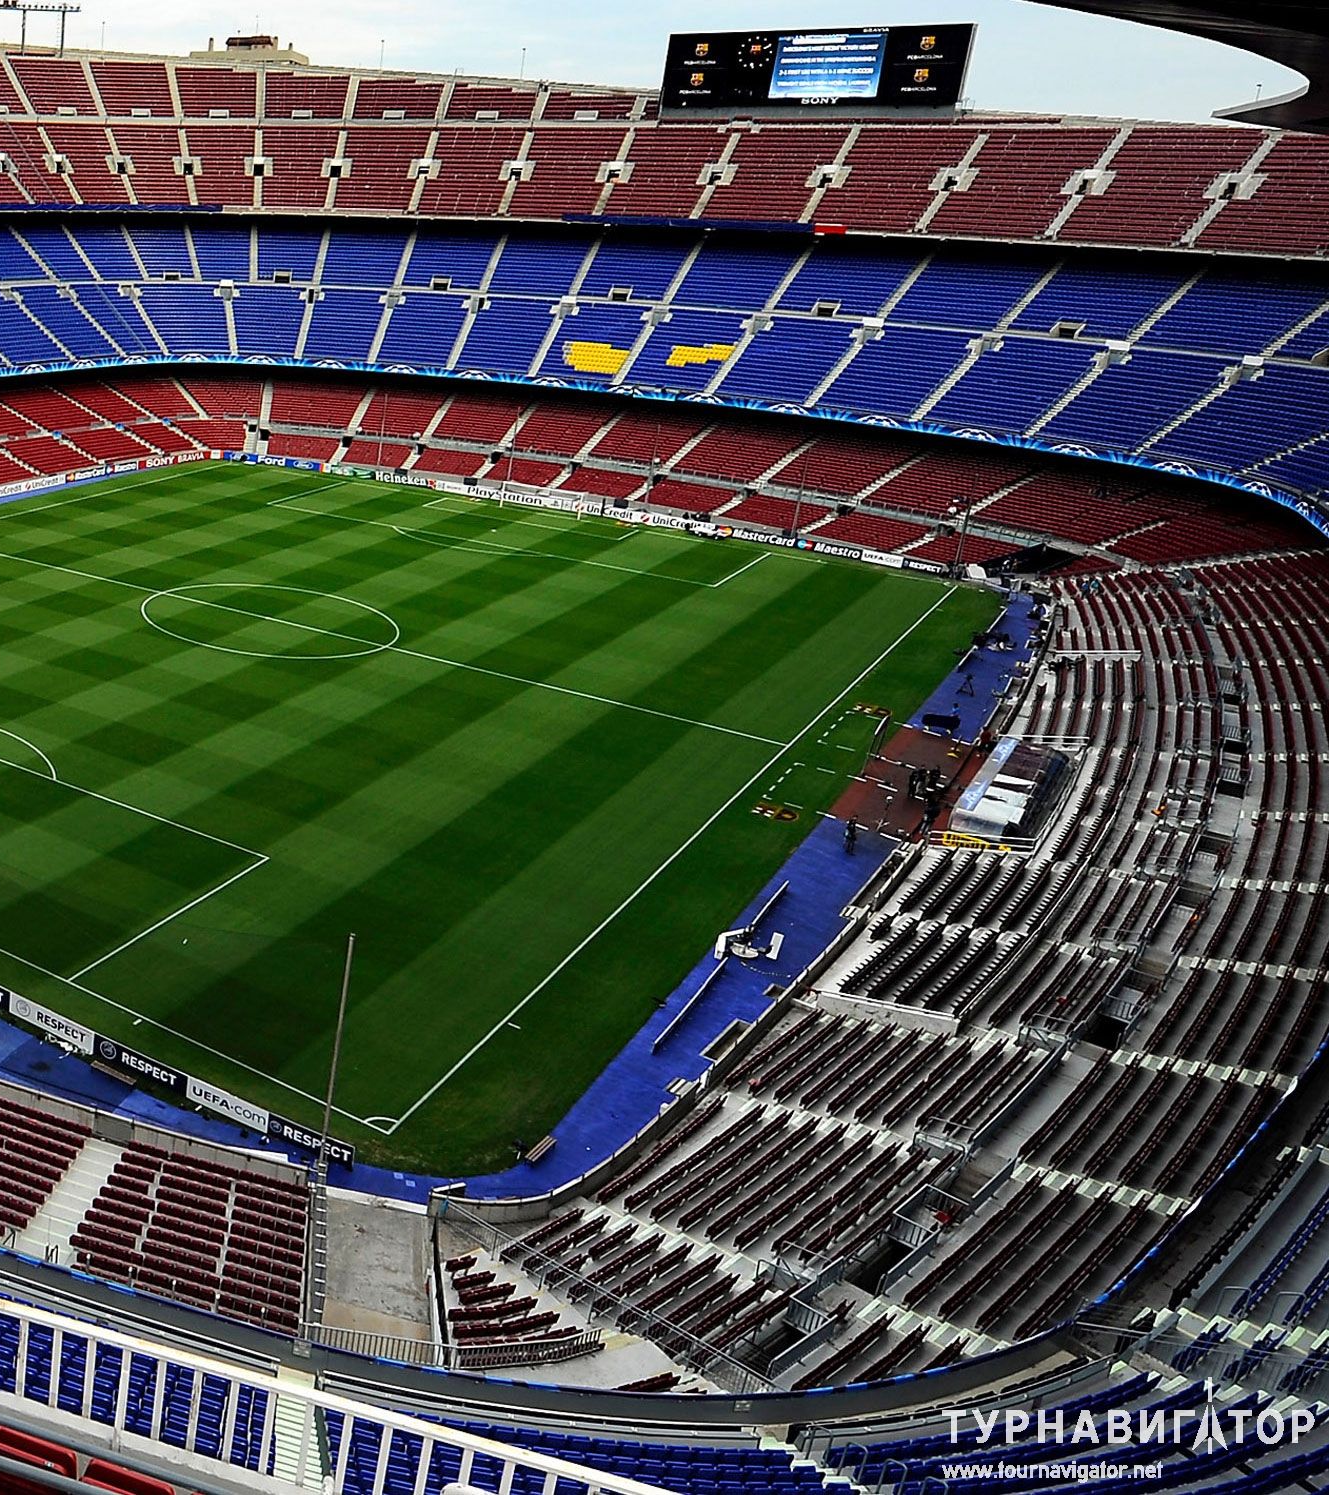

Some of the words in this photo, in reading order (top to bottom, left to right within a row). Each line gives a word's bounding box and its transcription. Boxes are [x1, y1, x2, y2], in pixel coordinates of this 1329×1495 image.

[801, 97, 839, 105] SONY
[146, 457, 175, 468] SONY
[177, 451, 204, 463] BRAVIA
[257, 455, 286, 467] Ford
[375, 471, 427, 486] Heineken
[467, 486, 542, 506] PlayStation
[586, 502, 633, 520] UnCredit
[732, 528, 796, 548] MasterCard
[814, 541, 860, 559] Maestro
[36, 1011, 86, 1043] RESPECT
[122, 1051, 177, 1086] RESPECT
[283, 1125, 352, 1162] RESPECT
